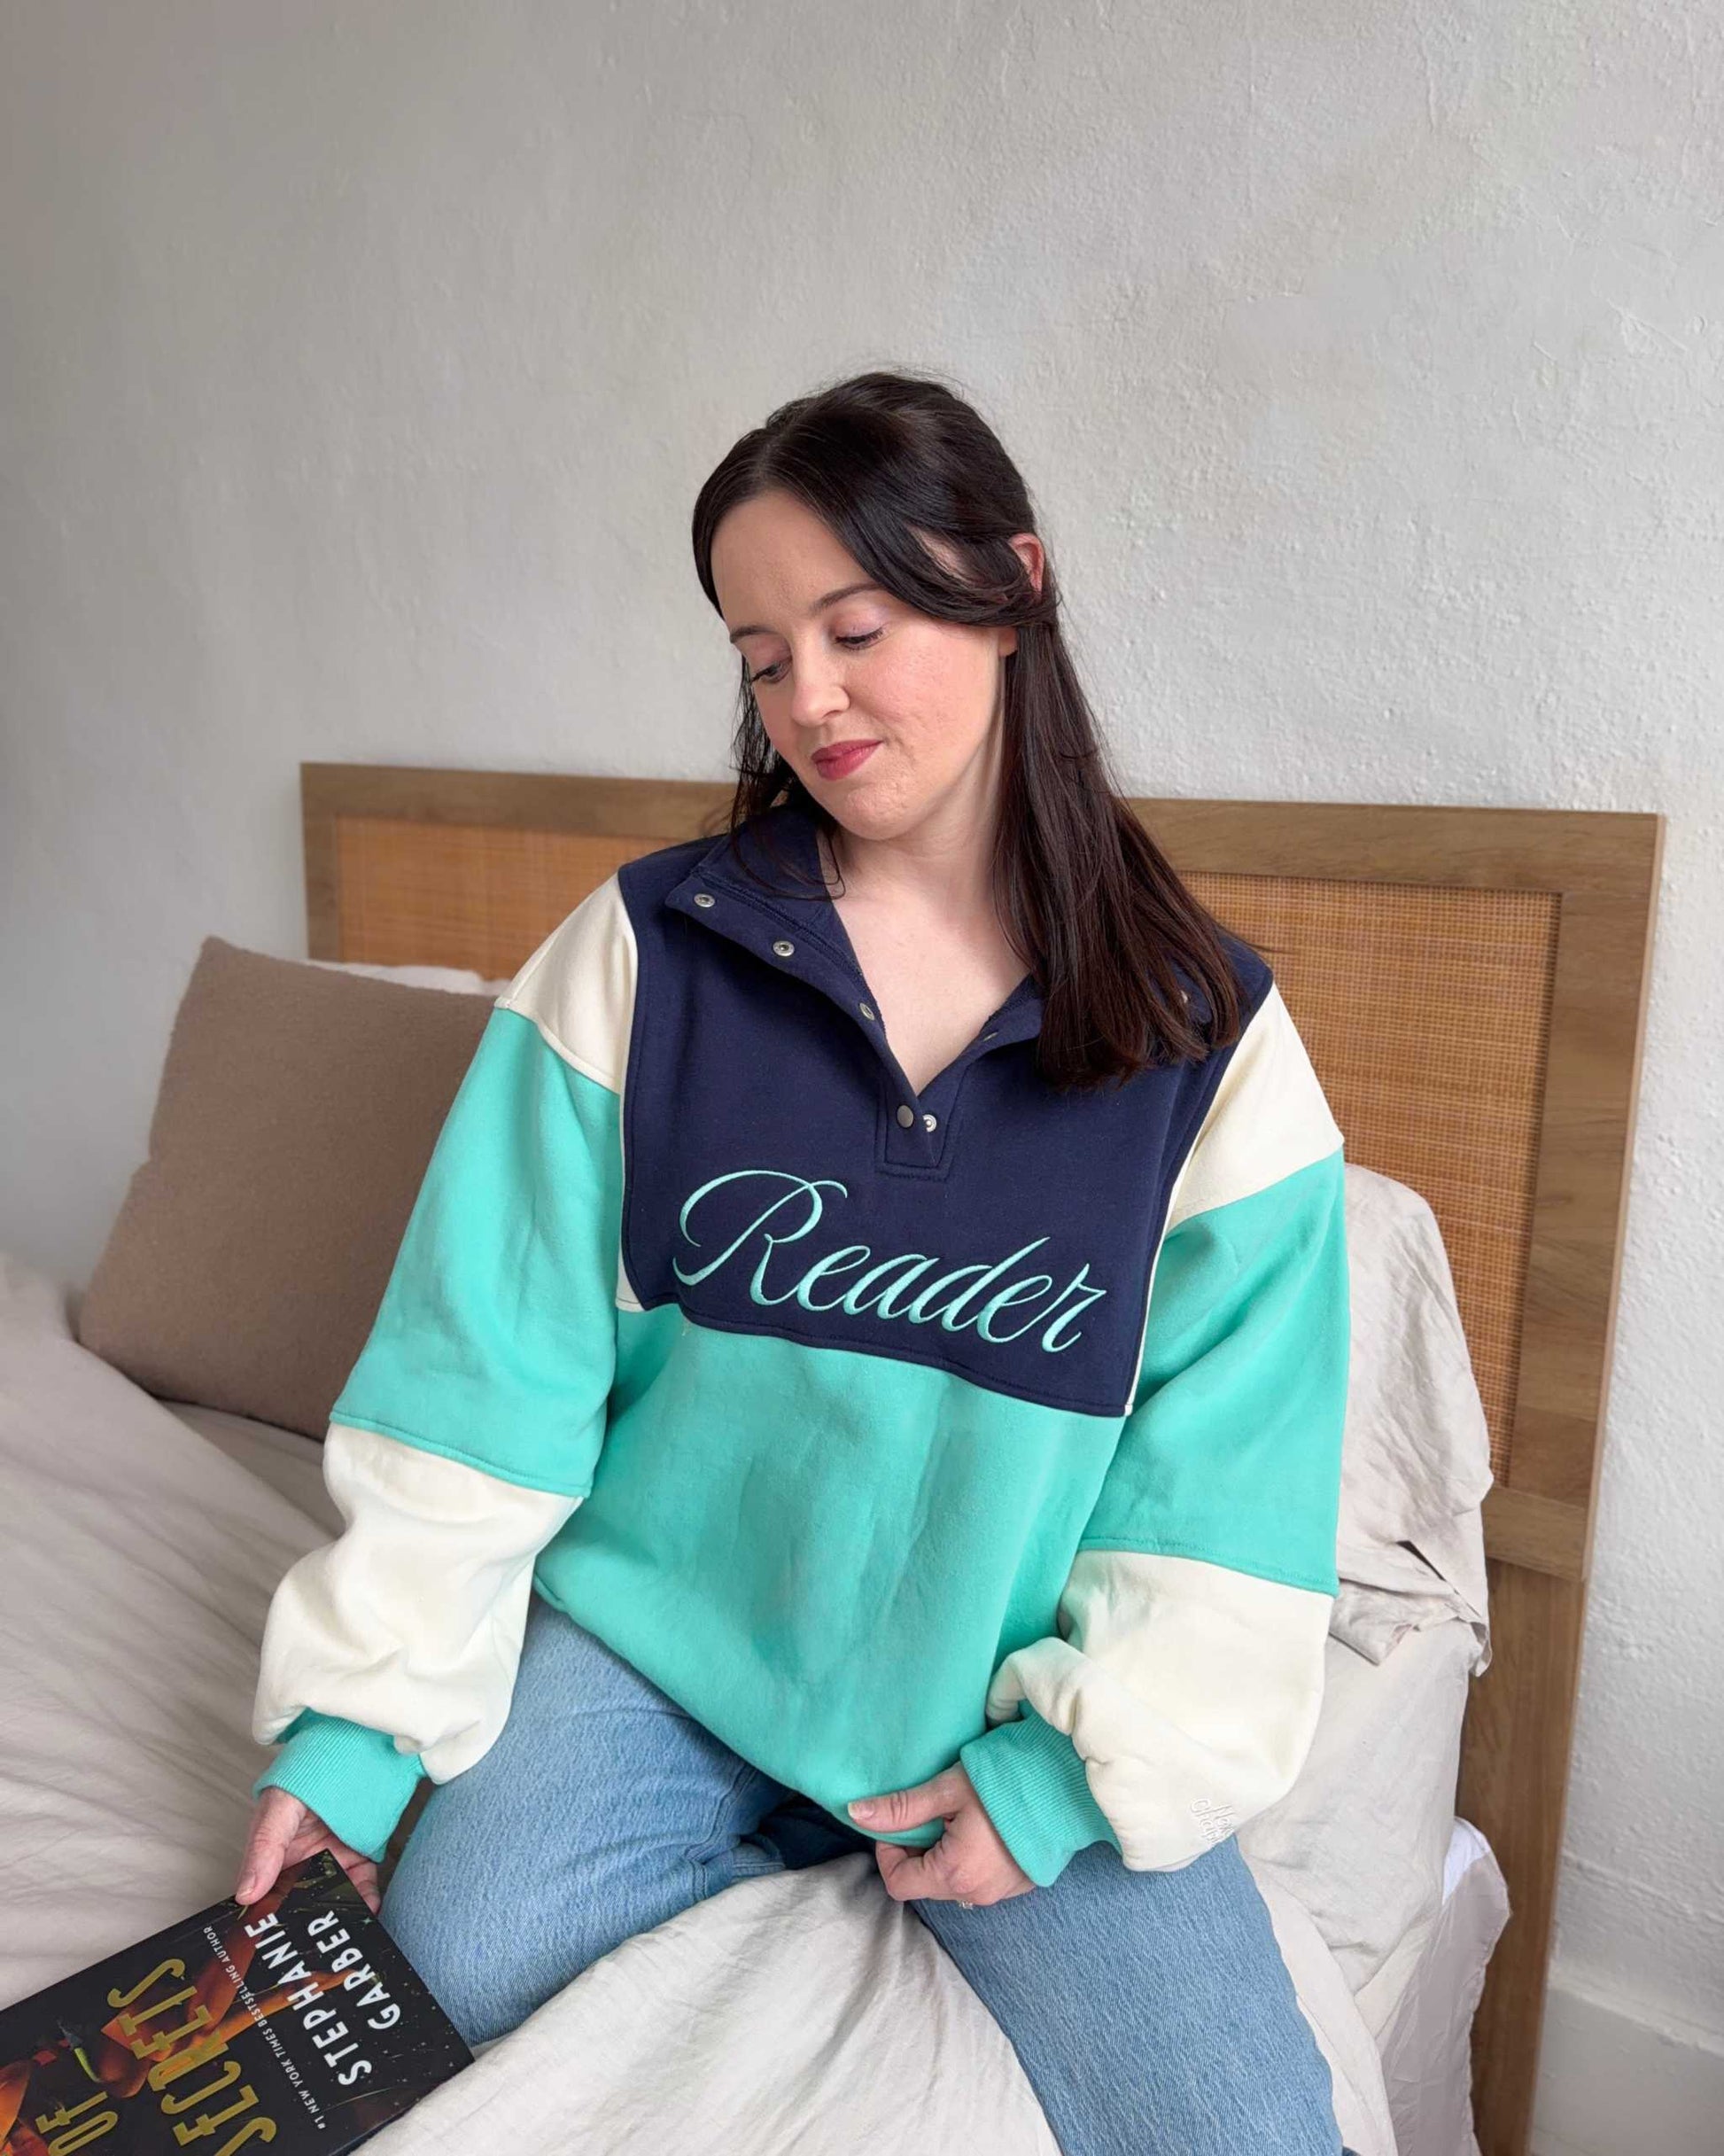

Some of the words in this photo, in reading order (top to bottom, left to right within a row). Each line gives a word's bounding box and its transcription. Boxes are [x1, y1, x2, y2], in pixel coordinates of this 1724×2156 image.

[672, 1170, 1107, 1352] Reader
[203, 1926, 229, 1965] AUTHOR
[307, 1911, 400, 2029] GARBER
[225, 1965, 268, 2028] BESTSELLING
[245, 1912, 372, 2085] STEPHANIE
[107, 1958, 276, 2156] SECRETS
[262, 2028, 286, 2058] TIMES
[281, 2059, 303, 2087] YORK
[35, 2091, 118, 2156] OF
[299, 2089, 322, 2114] NEW
[314, 2115, 326, 2129] #1
